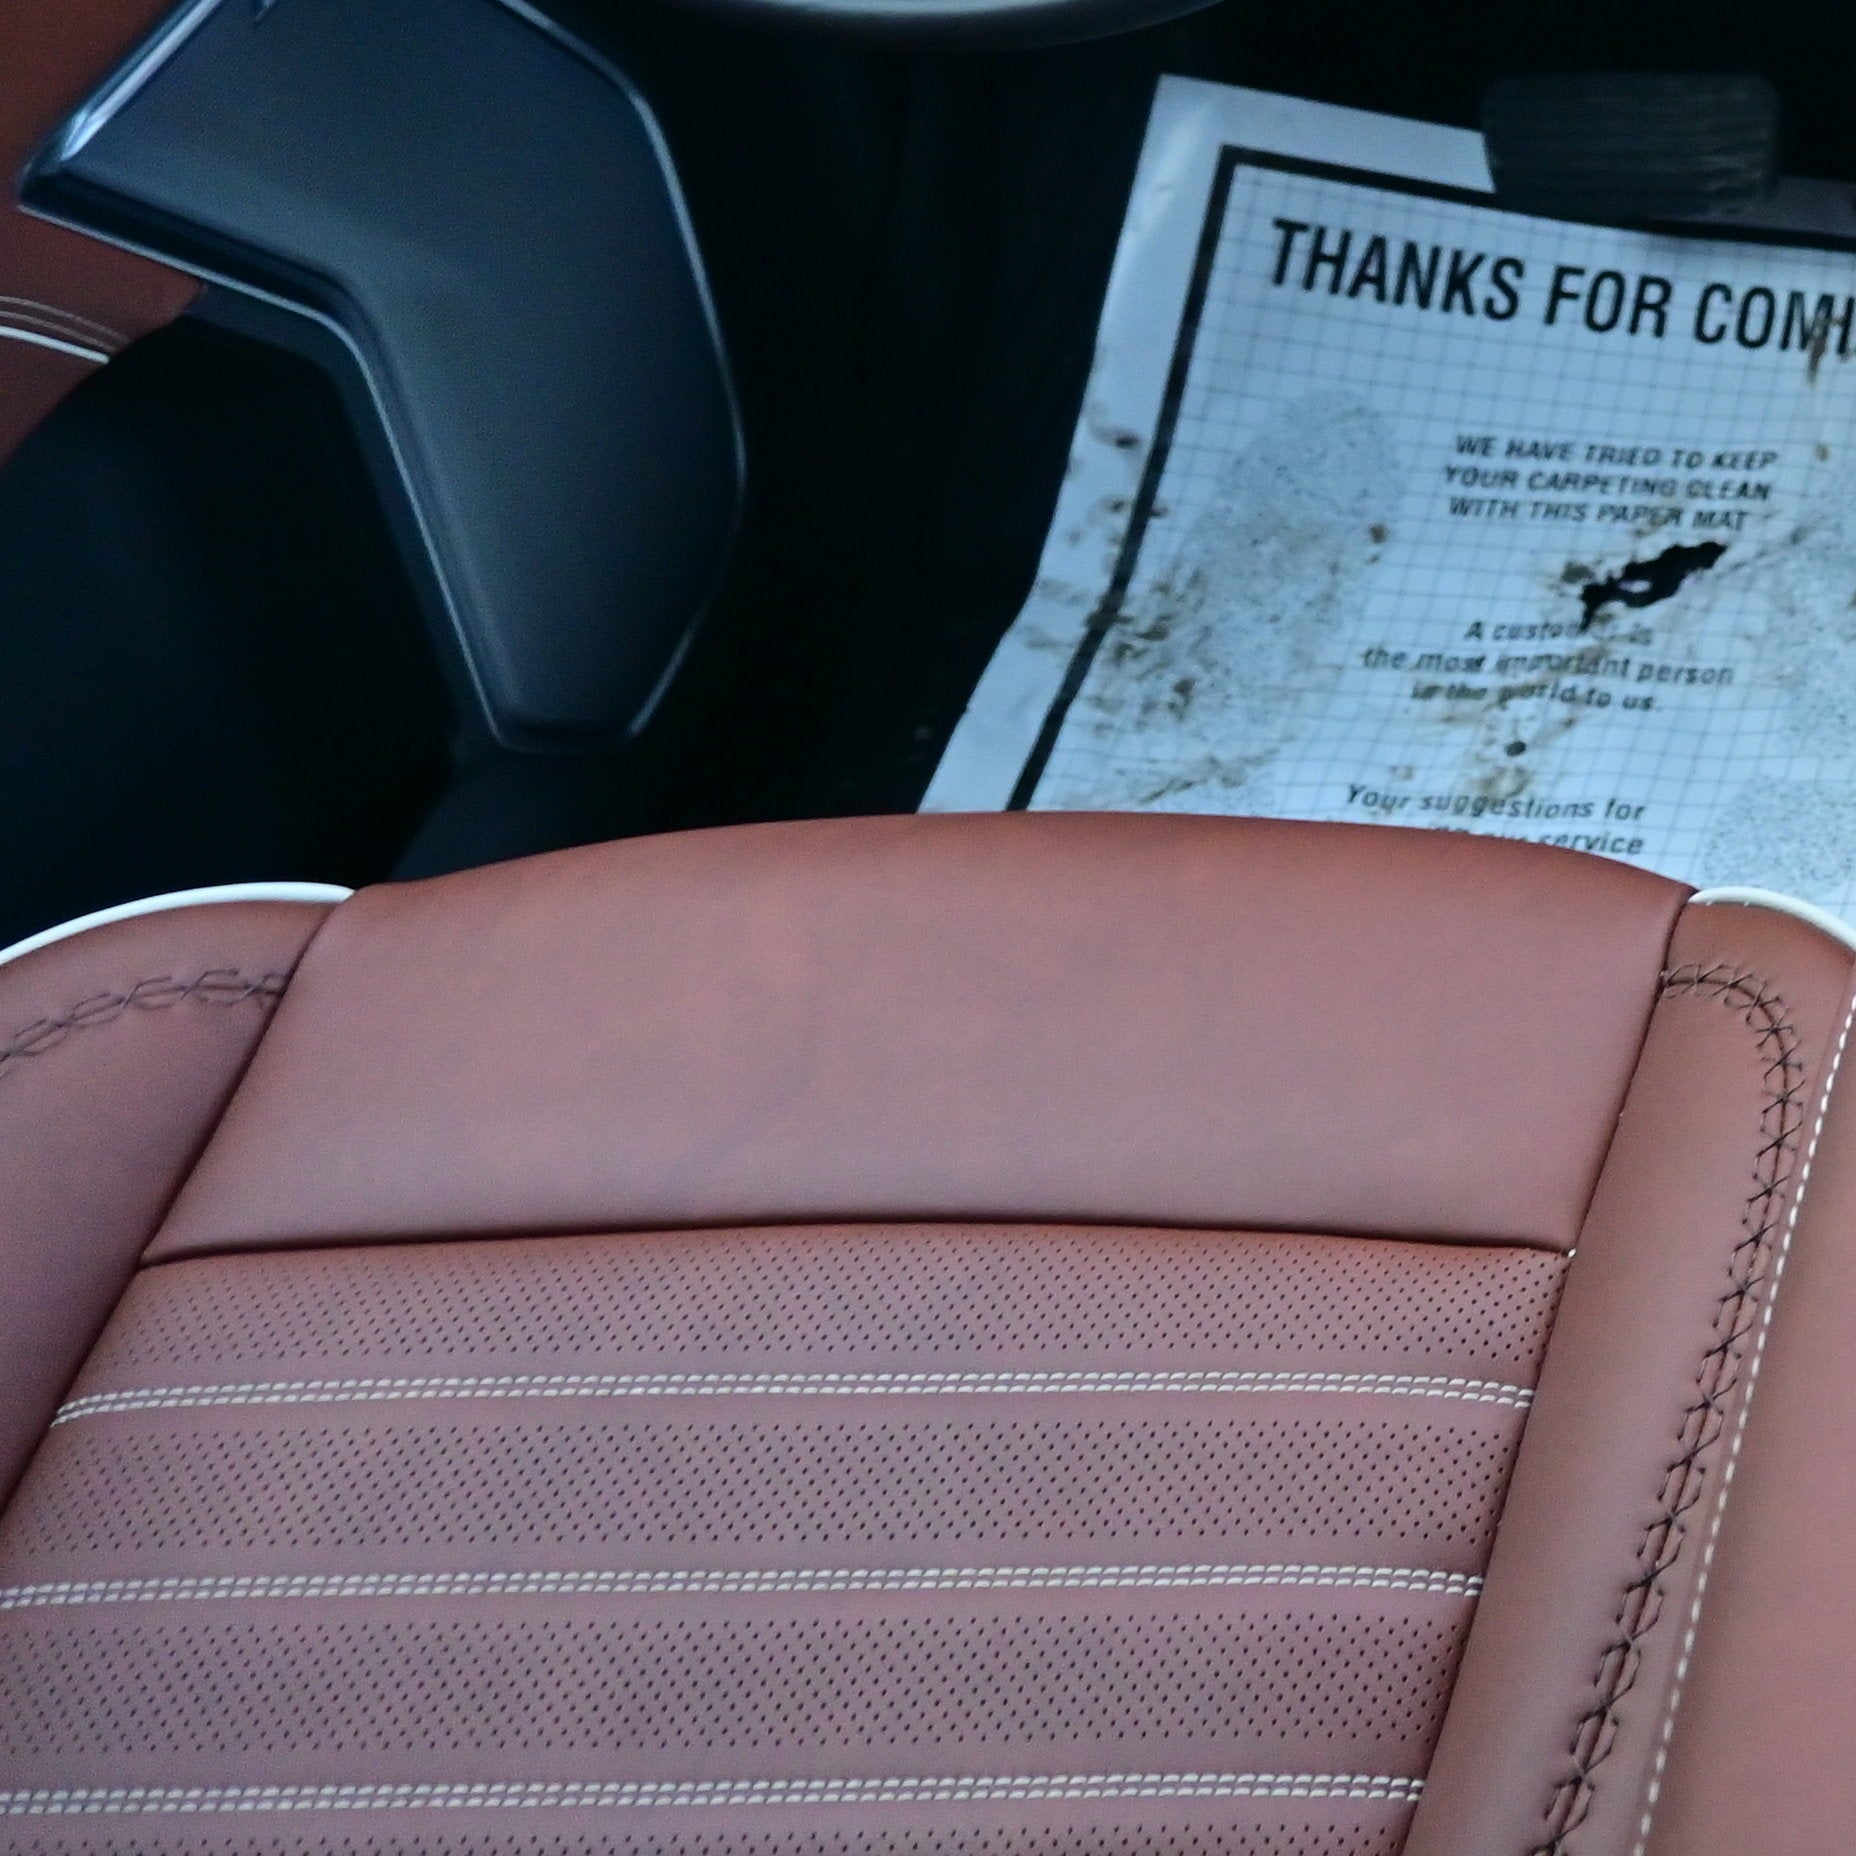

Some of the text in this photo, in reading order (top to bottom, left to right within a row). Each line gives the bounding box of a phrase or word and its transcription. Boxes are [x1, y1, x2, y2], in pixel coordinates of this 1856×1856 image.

[1268, 218, 1525, 323] THANKS
[1542, 264, 1673, 340] FOR
[1456, 435, 1778, 471] WE HAVE TRIED TO KEEP
[1445, 464, 1773, 502] YOUR CARPETING CLEAN
[1449, 496, 1749, 532] WITH THIS PAPER MAT
[1463, 620, 1485, 643] A
[1360, 645, 1735, 687] the most important person
[1585, 687, 1613, 709] to
[1346, 784, 1647, 821] Your suggestions for
